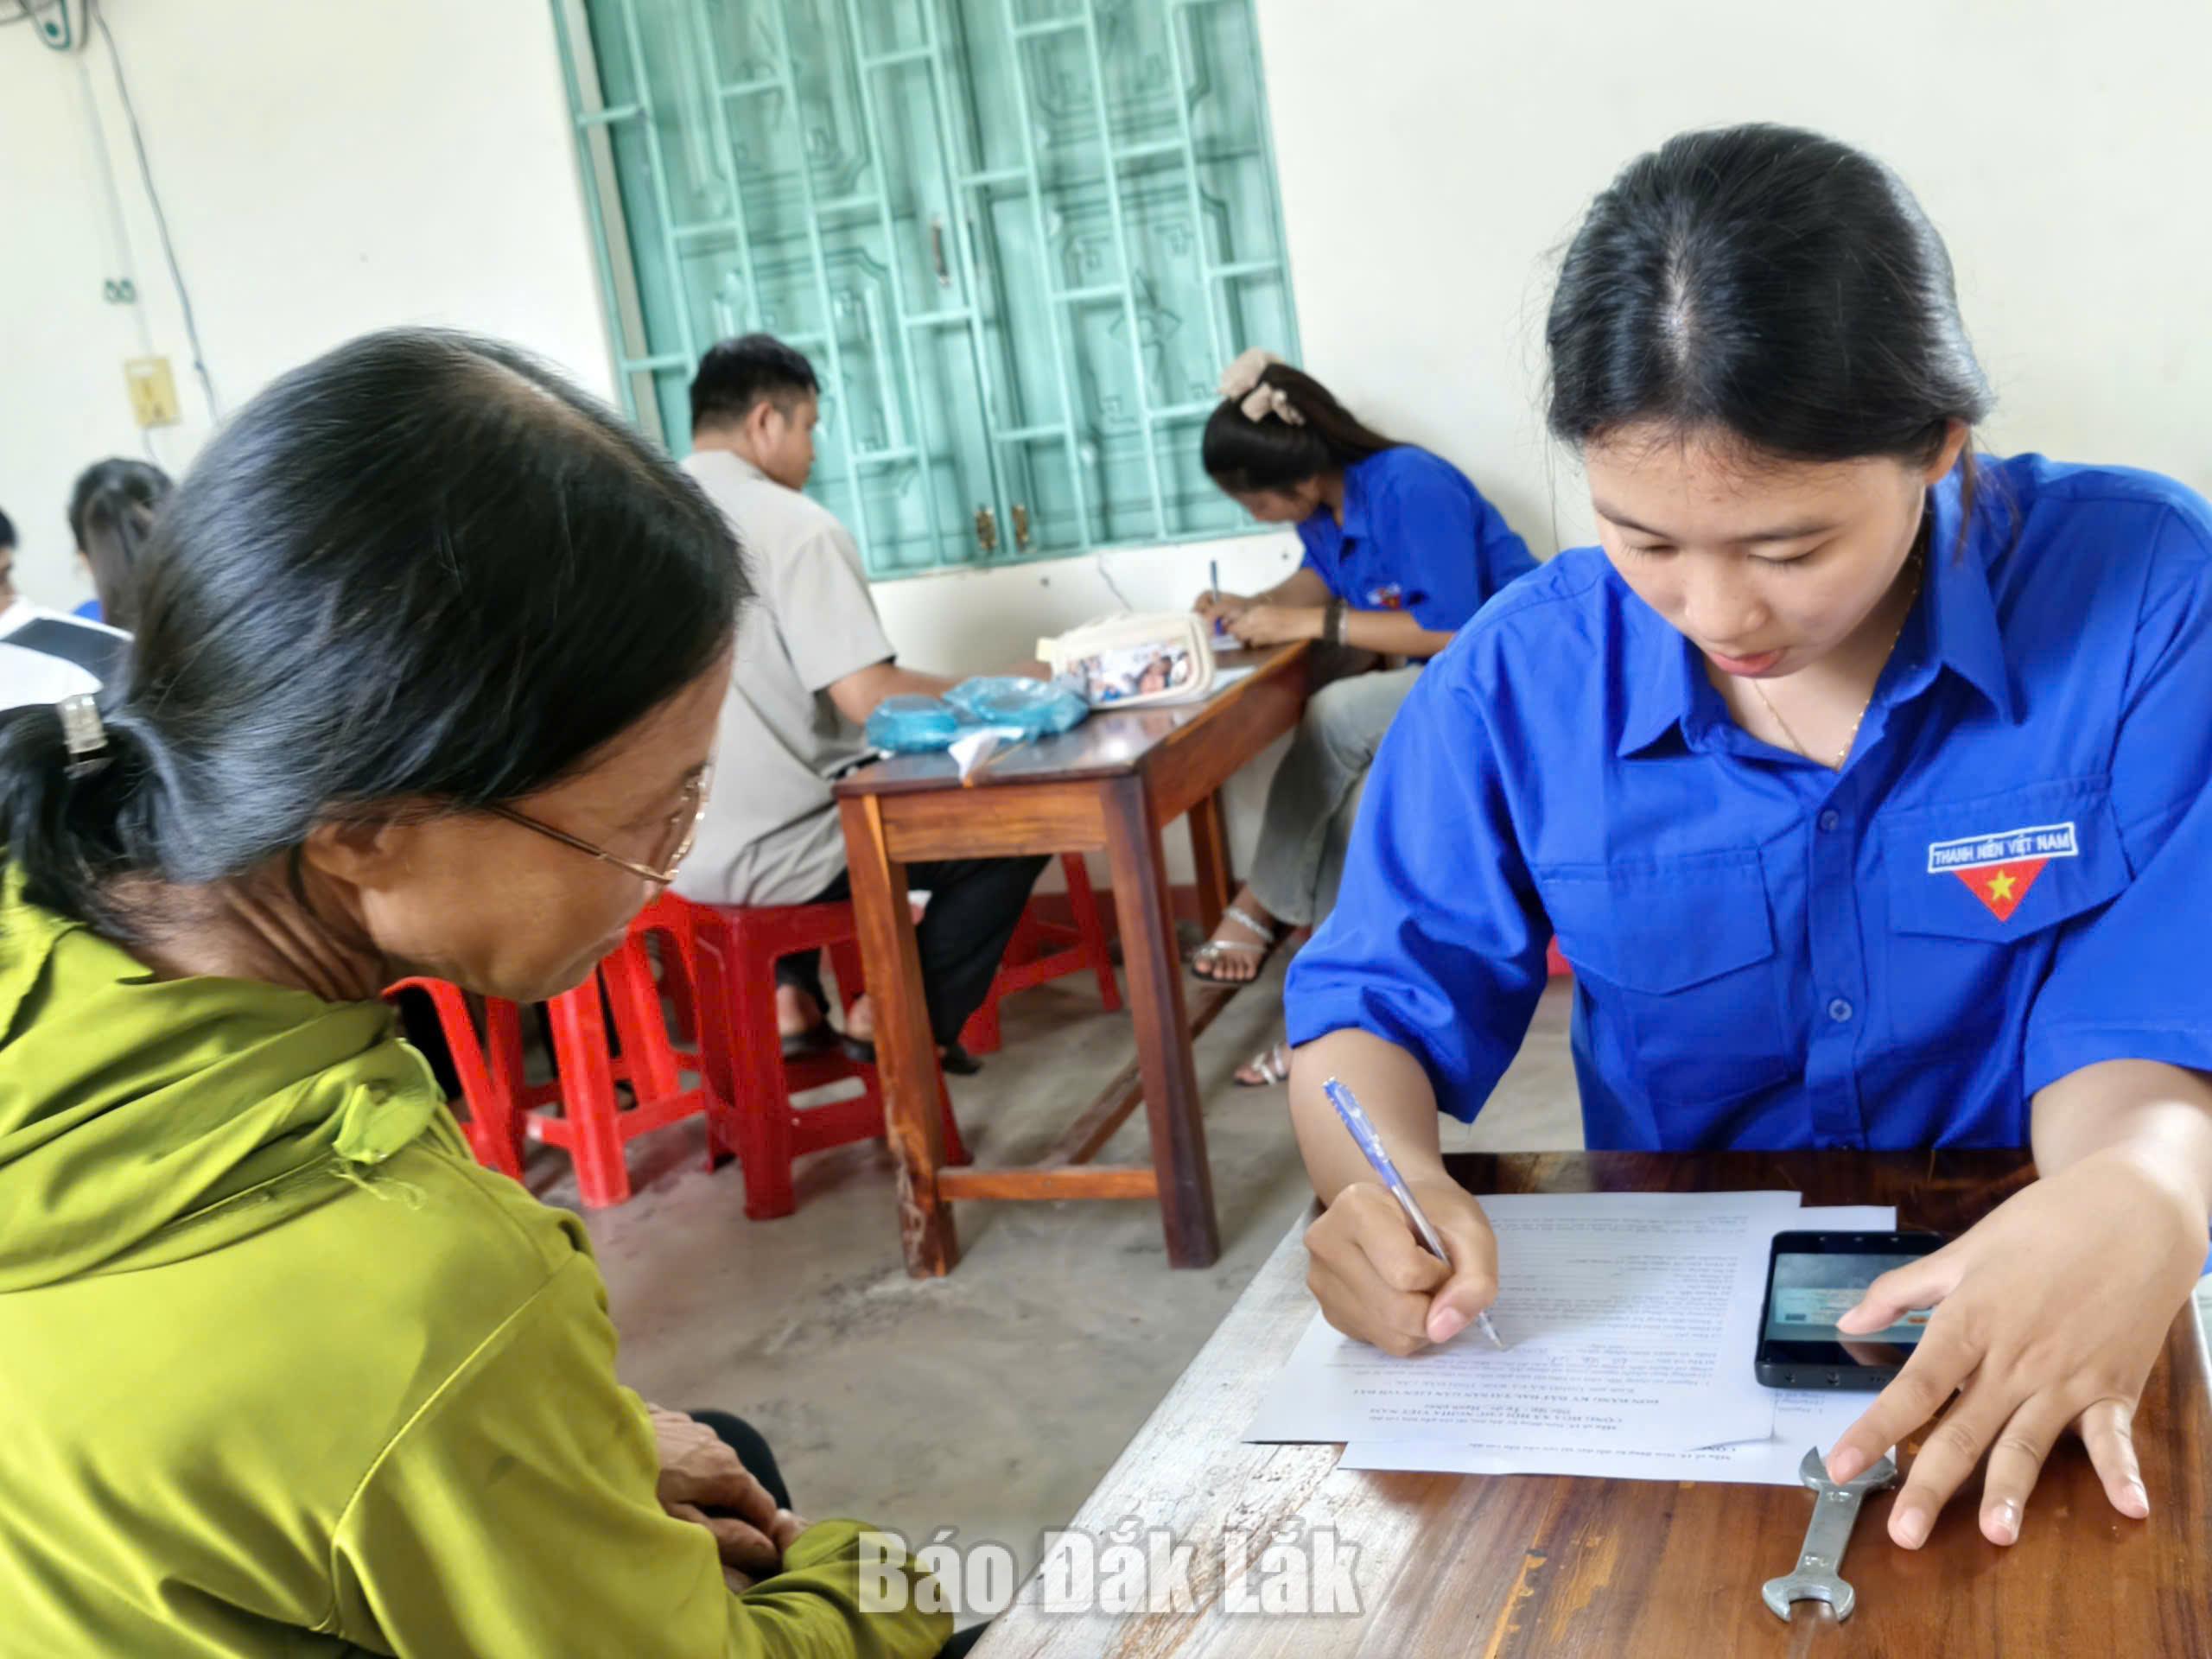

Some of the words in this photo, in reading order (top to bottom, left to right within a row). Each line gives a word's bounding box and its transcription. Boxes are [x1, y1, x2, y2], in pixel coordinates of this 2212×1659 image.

[1935, 846, 1974, 865] THANH
[2006, 834, 2032, 857] VIỆT
[2036, 832, 2069, 850] NAM
